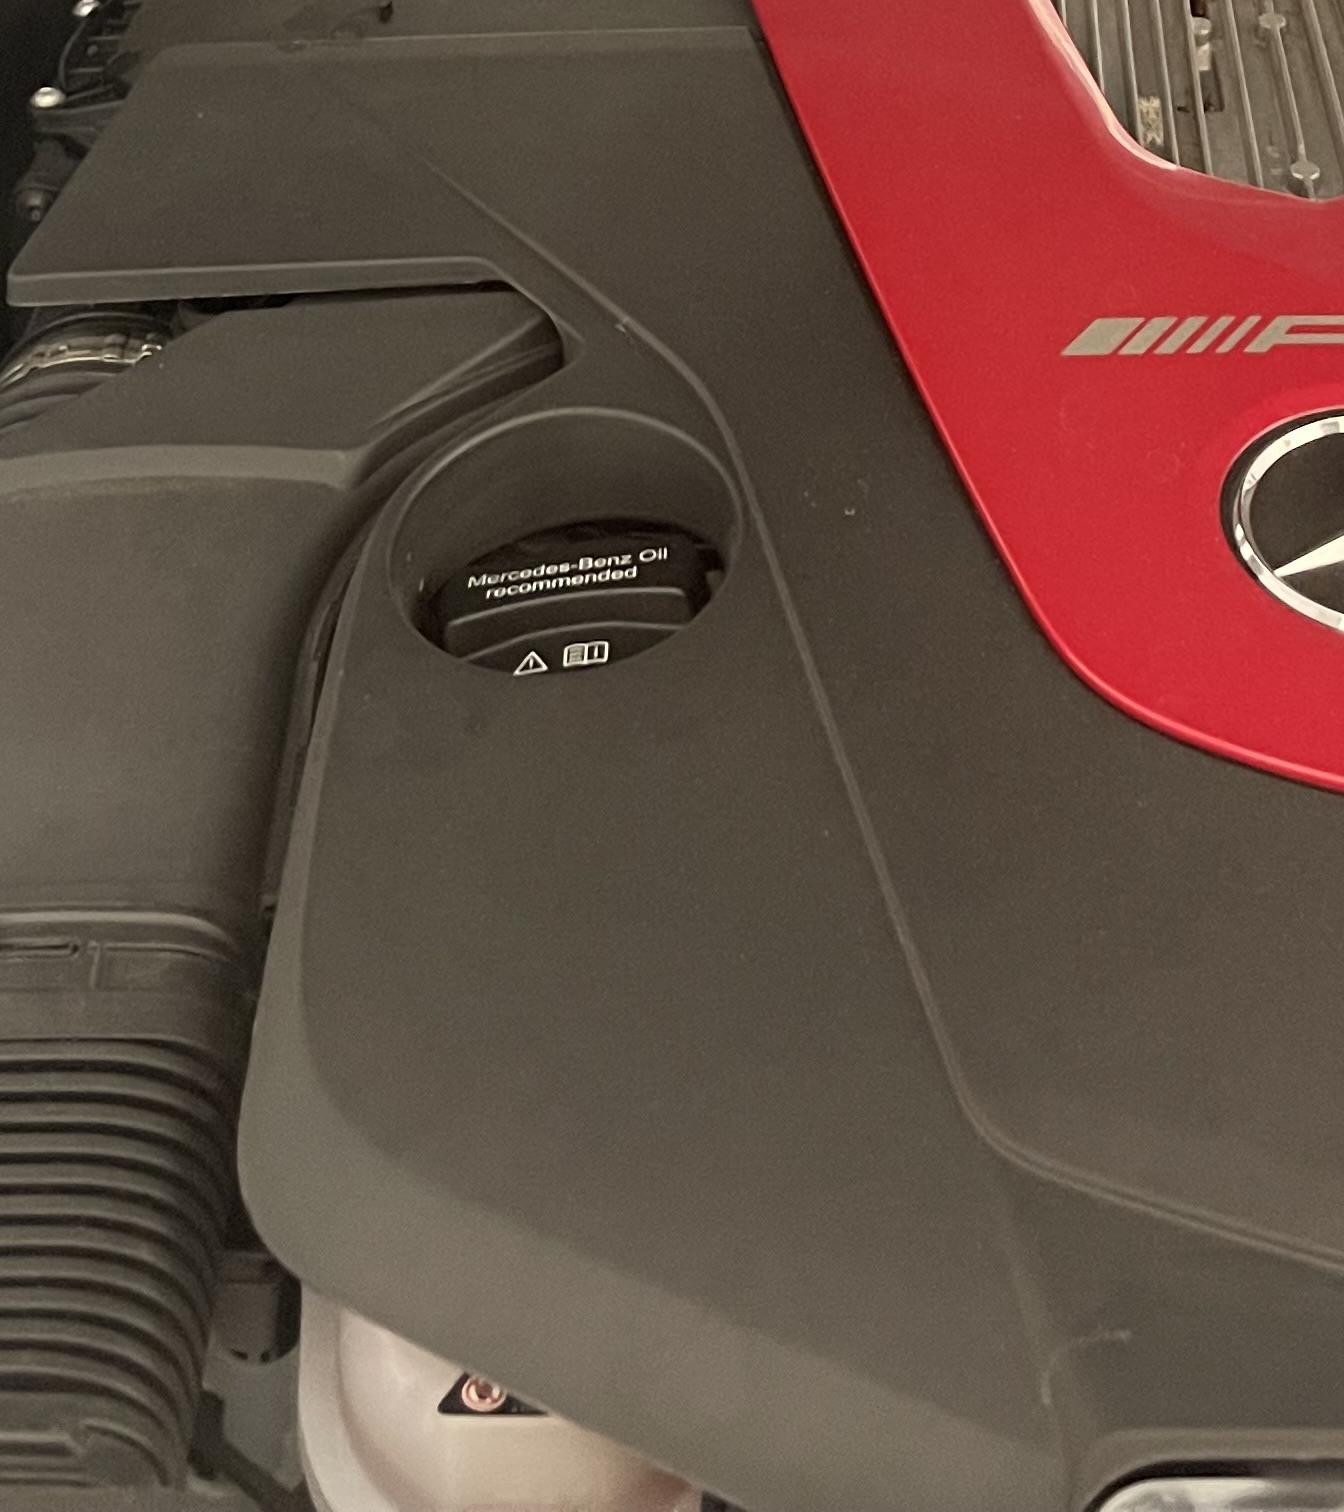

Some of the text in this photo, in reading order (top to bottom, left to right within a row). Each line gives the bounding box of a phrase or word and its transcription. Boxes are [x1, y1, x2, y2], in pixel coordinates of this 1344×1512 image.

[467, 546, 669, 589] Mercedes-Benz Oil
[485, 565, 638, 600] recommended
